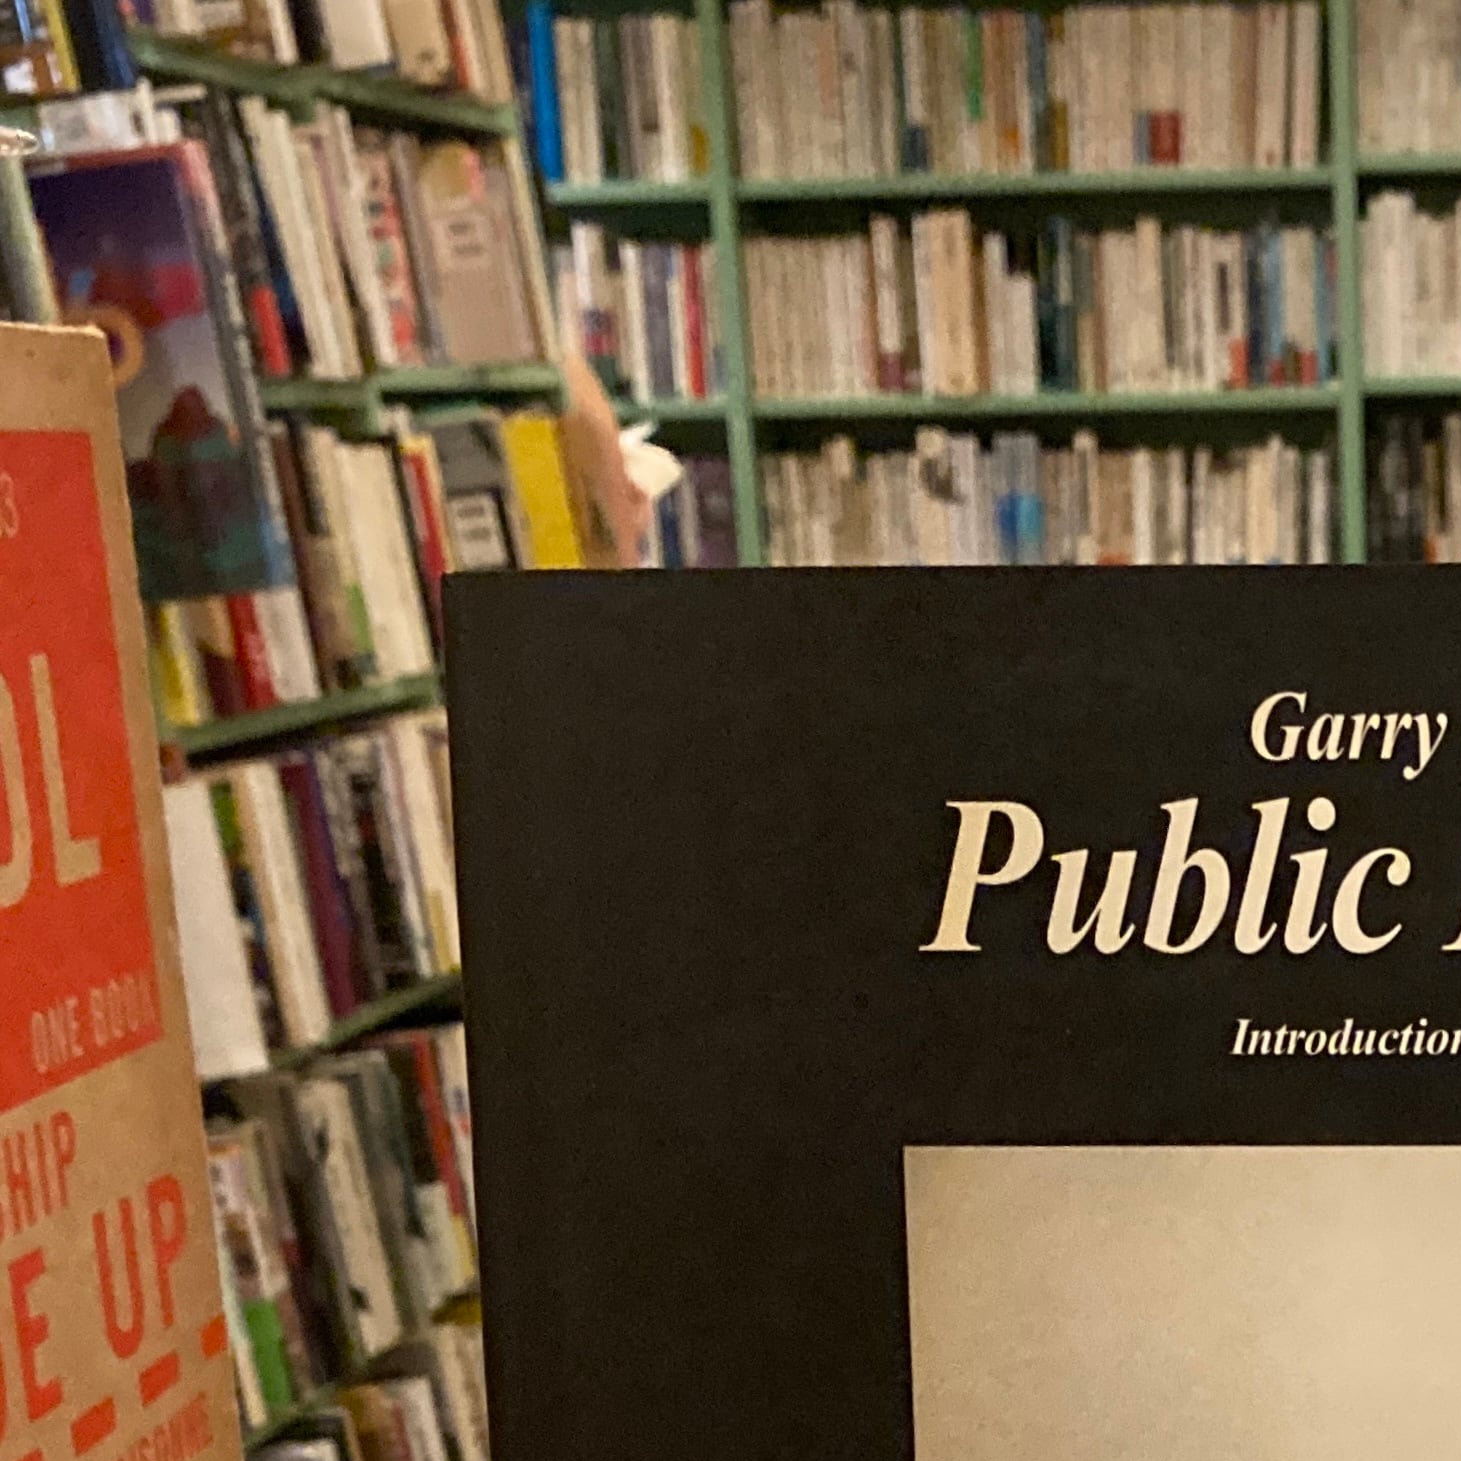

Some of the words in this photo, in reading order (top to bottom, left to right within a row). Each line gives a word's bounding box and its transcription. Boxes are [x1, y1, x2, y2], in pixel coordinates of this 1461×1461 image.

[1251, 692, 1447, 780] Garry
[919, 797, 1410, 955] Public
[31, 996, 84, 1073] ONE
[0, 1111, 76, 1240] HIP
[0, 1250, 63, 1442] E
[93, 1174, 187, 1359] UP
